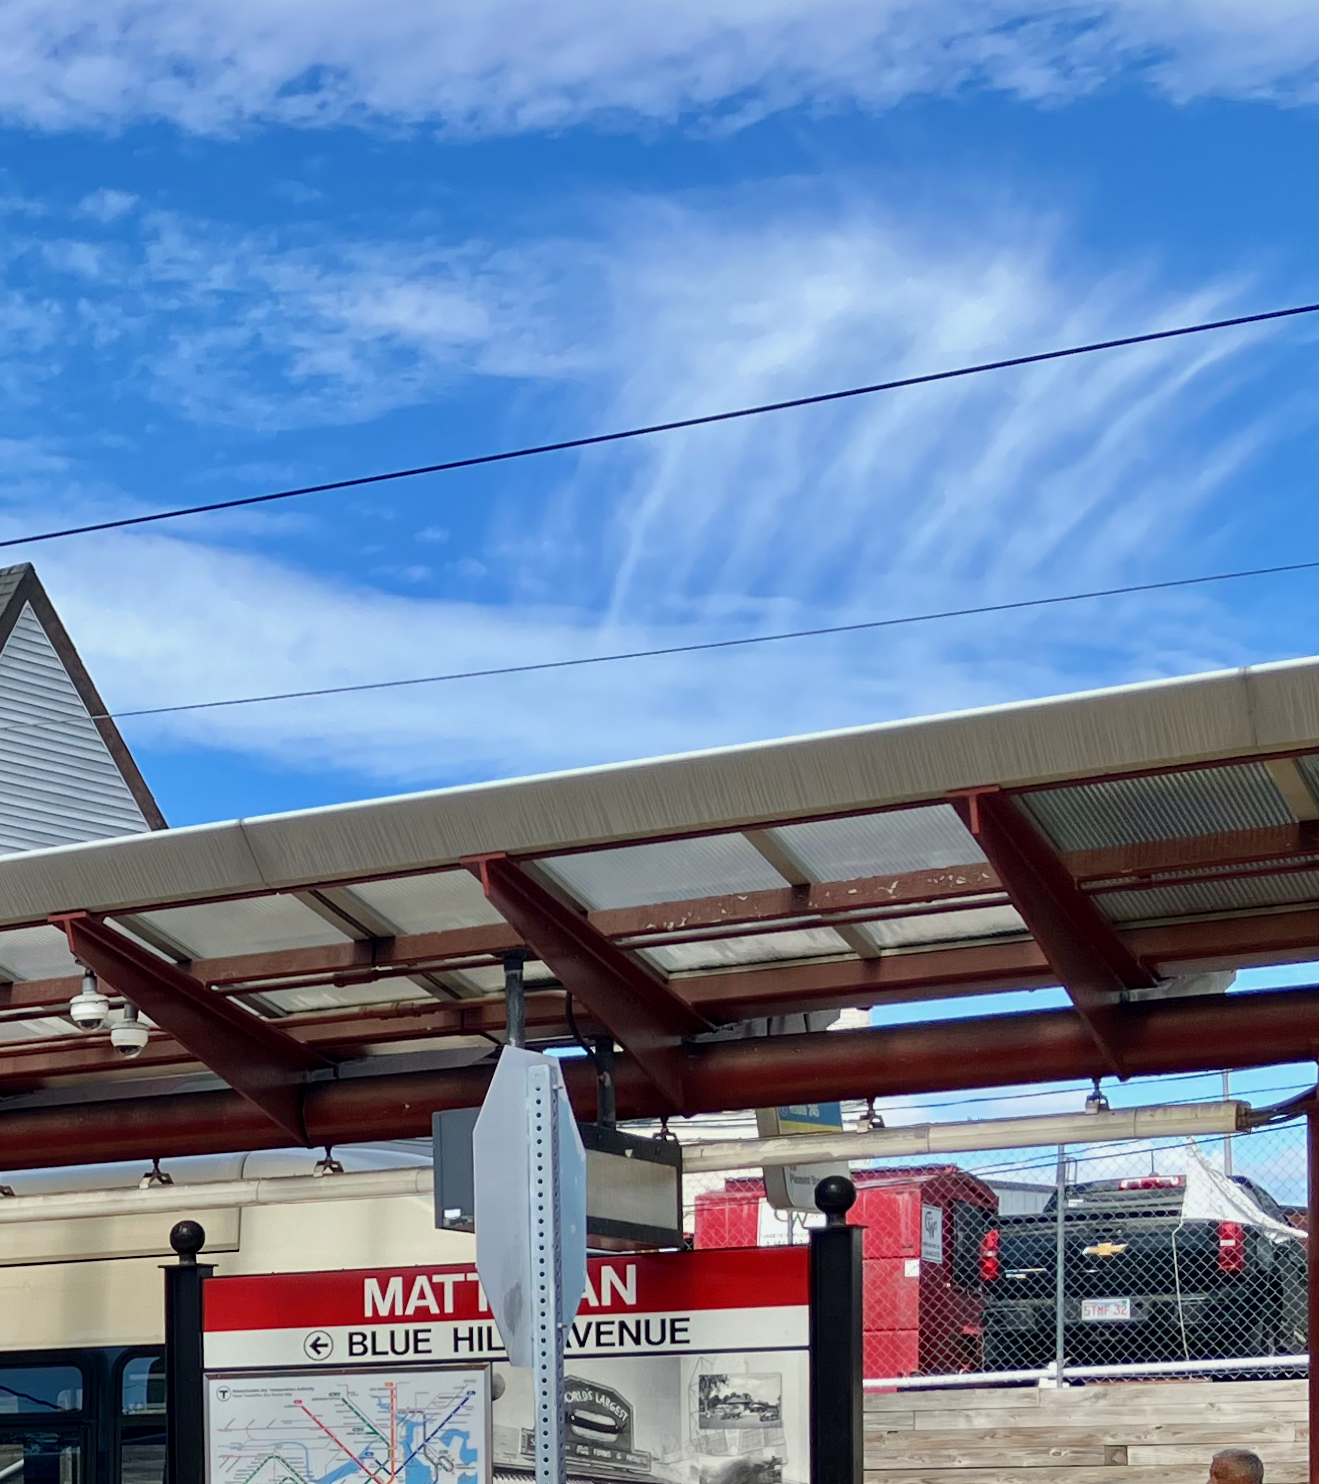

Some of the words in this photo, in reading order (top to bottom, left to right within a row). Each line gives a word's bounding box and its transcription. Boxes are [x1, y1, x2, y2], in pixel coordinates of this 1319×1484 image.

[364, 1263, 636, 1318] MATTAN
[347, 1328, 432, 1358] BLUE
[453, 1325, 506, 1353] HIL
[566, 1317, 691, 1349] VENUE
[595, 1393, 629, 1421] LARGEST
